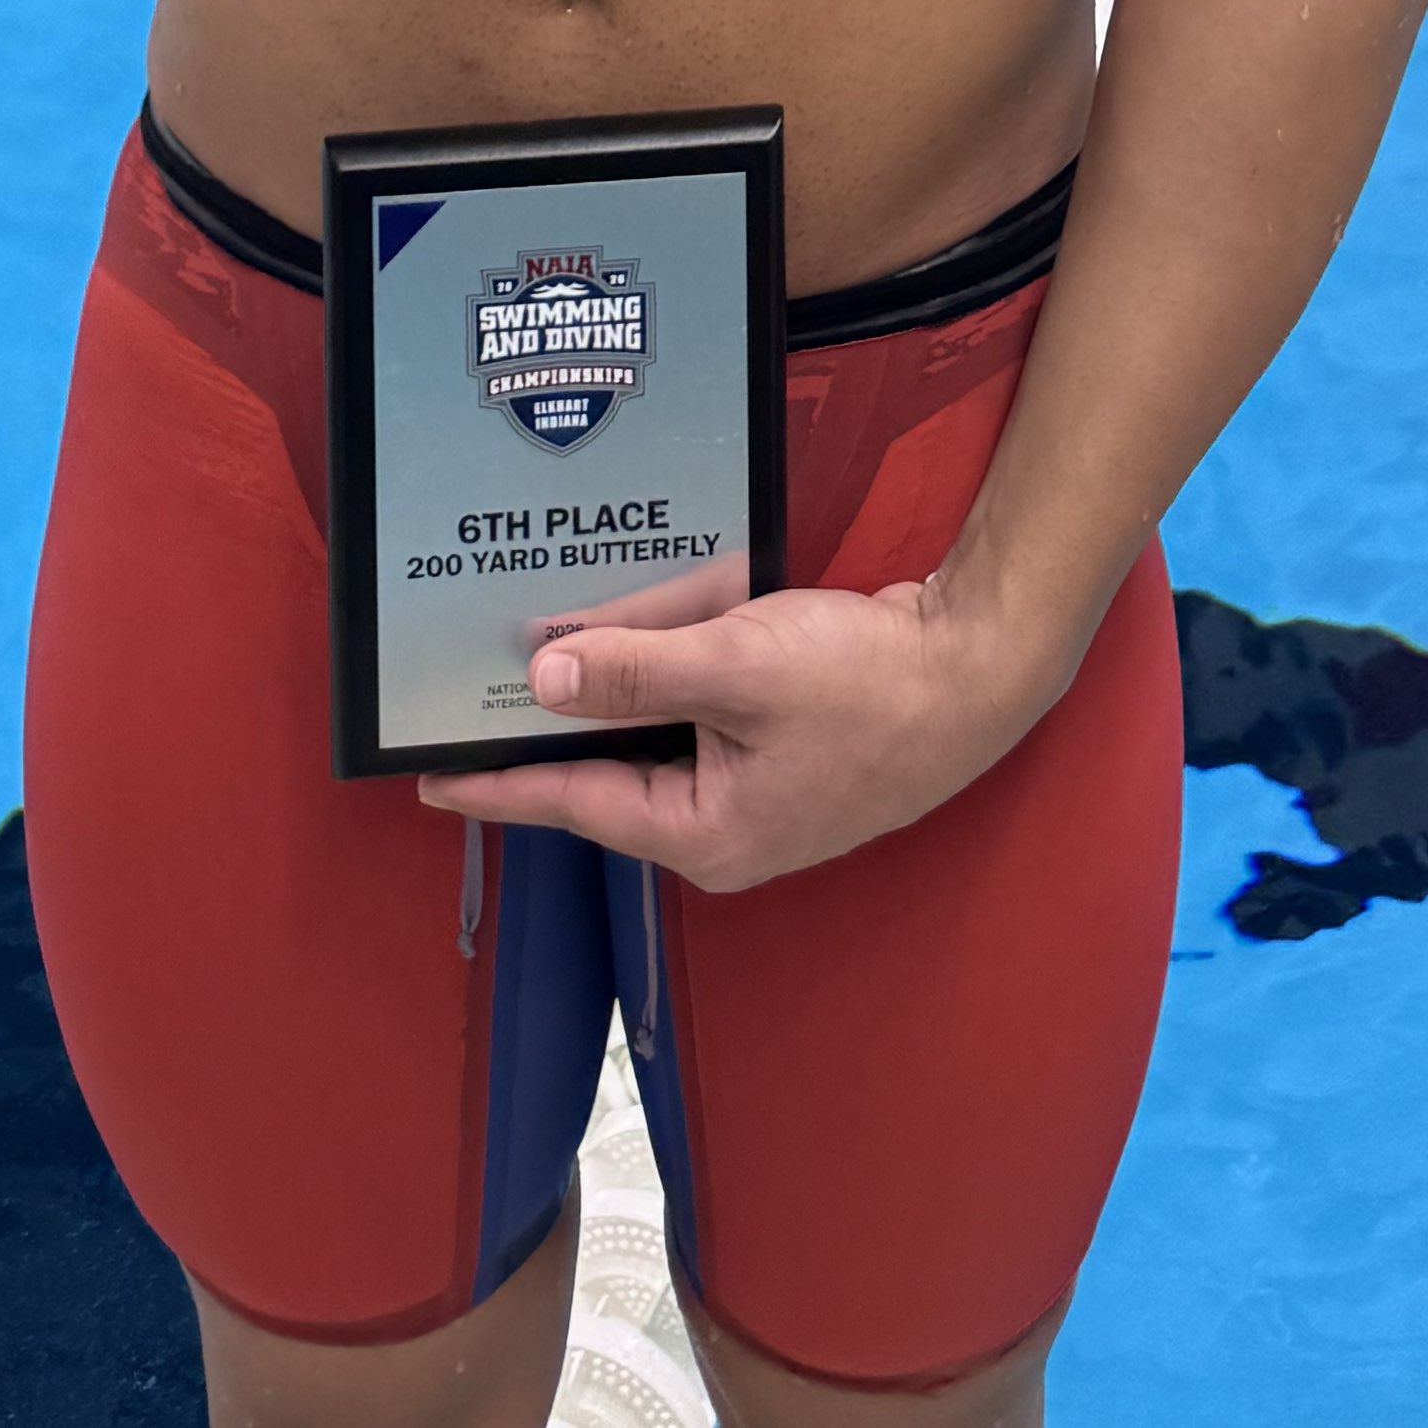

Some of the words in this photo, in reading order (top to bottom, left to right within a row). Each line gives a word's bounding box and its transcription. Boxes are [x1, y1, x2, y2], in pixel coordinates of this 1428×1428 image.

[526, 254, 594, 284] NAIA
[479, 295, 641, 331] SWIMMING
[480, 329, 539, 363] AND
[545, 322, 641, 351] DIVING
[489, 367, 634, 395] CHAMPIONSHIPS
[533, 398, 590, 415] ELKHART
[534, 414, 589, 430] INDIANA
[458, 510, 530, 544] 6TH
[546, 499, 670, 537] PLACE
[407, 554, 462, 579] 200
[471, 547, 549, 574] YARD
[560, 532, 720, 568] BUTTERFLY
[481, 696, 539, 709] INTERCOL
[487, 683, 530, 695] NATION
